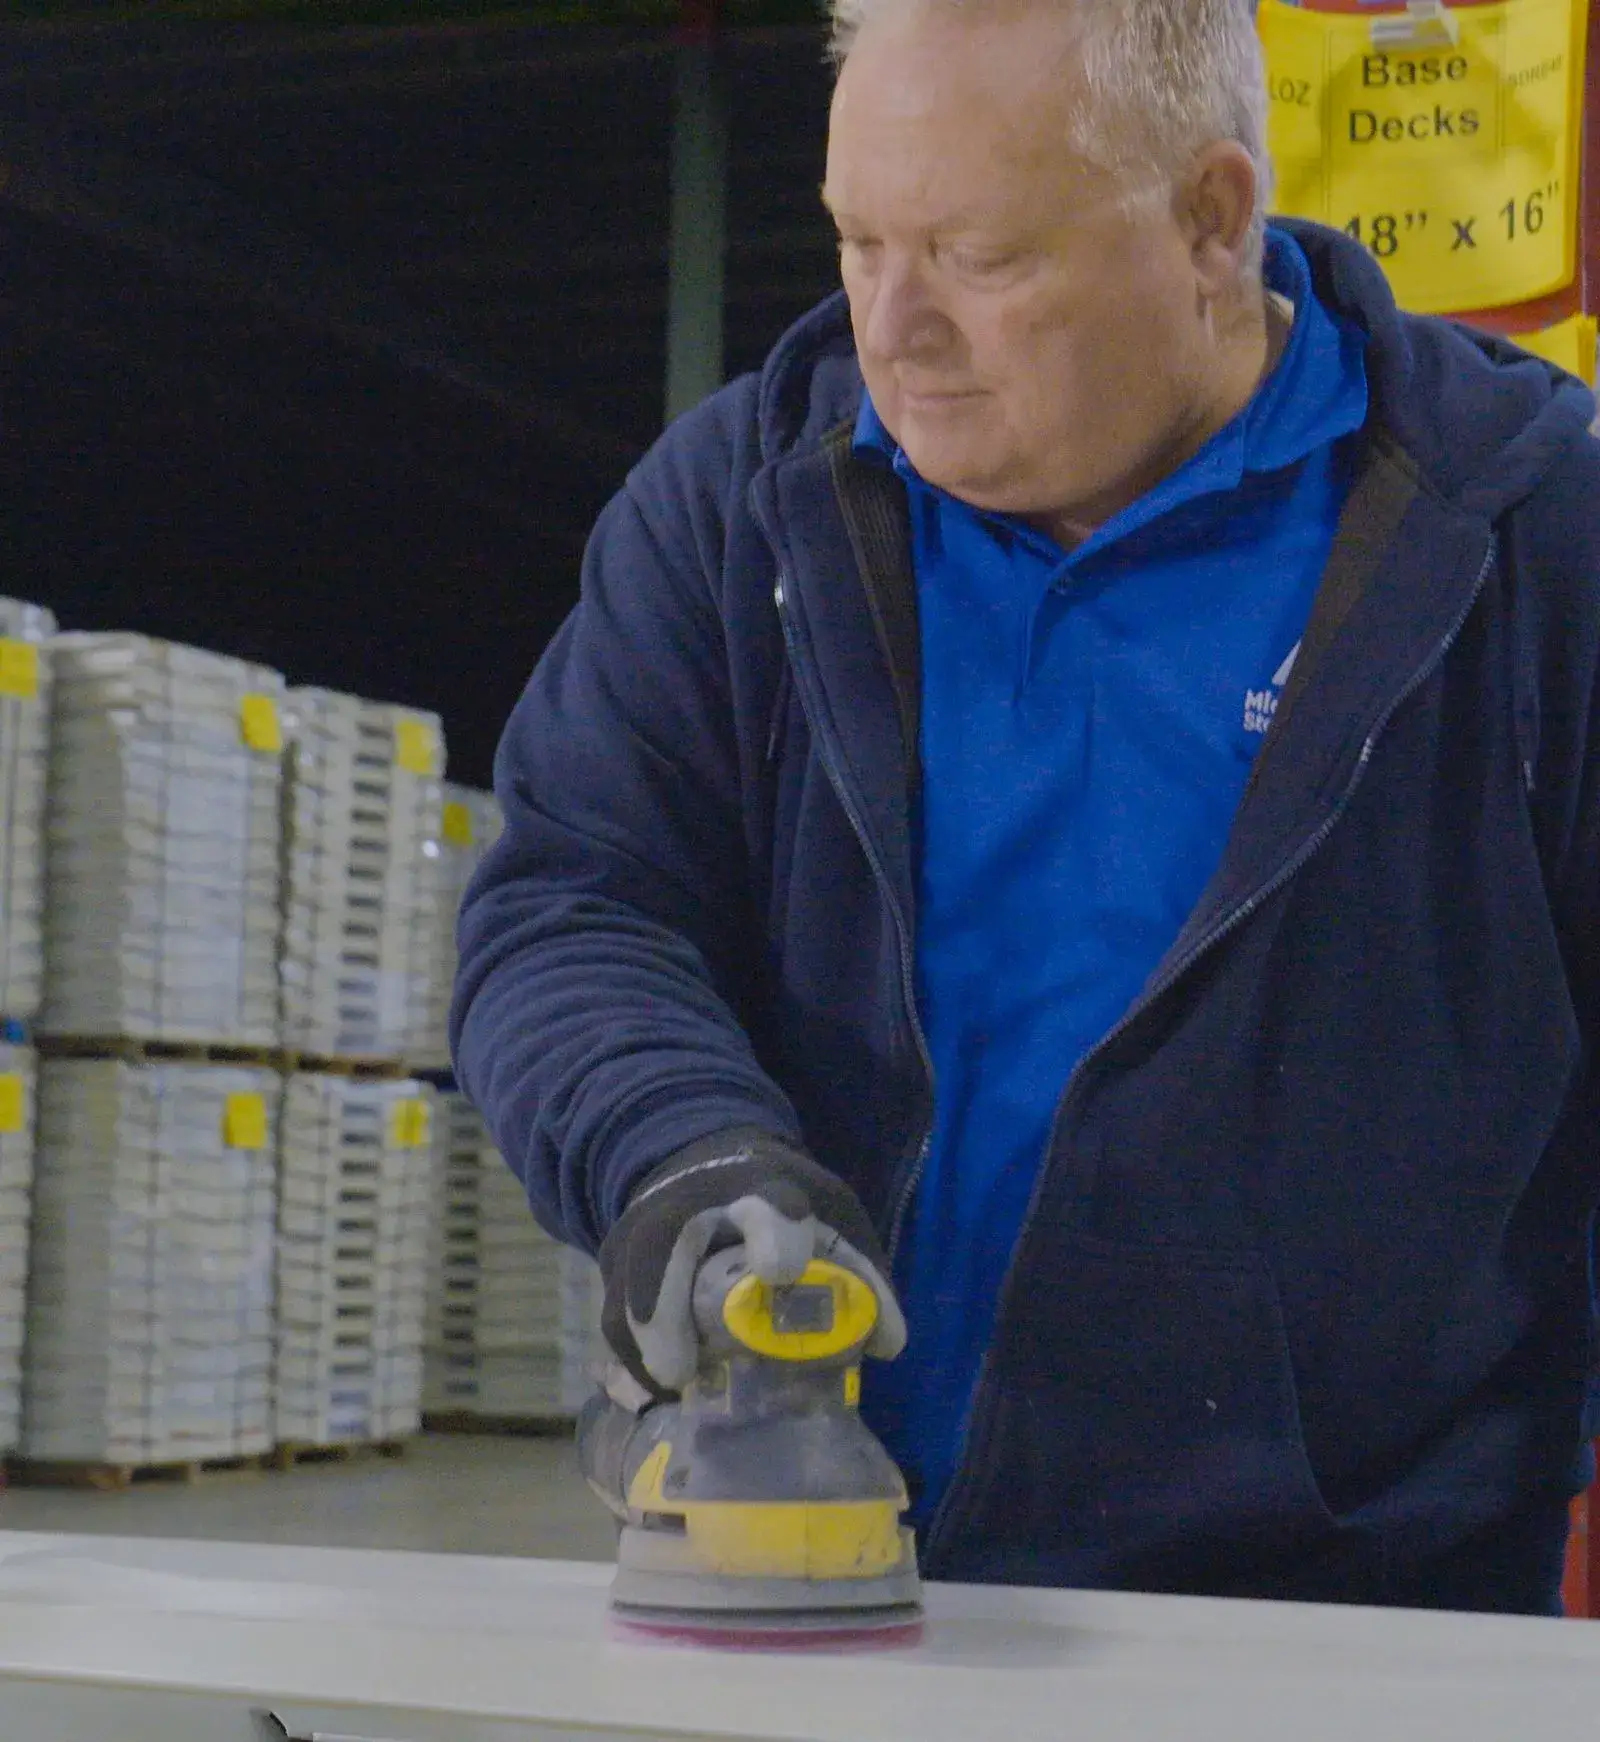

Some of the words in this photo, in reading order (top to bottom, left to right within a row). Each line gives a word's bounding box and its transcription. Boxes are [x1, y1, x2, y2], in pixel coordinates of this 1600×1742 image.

[1363, 53, 1468, 88] Base
[1349, 104, 1479, 144] Decks
[1450, 216, 1477, 251] x
